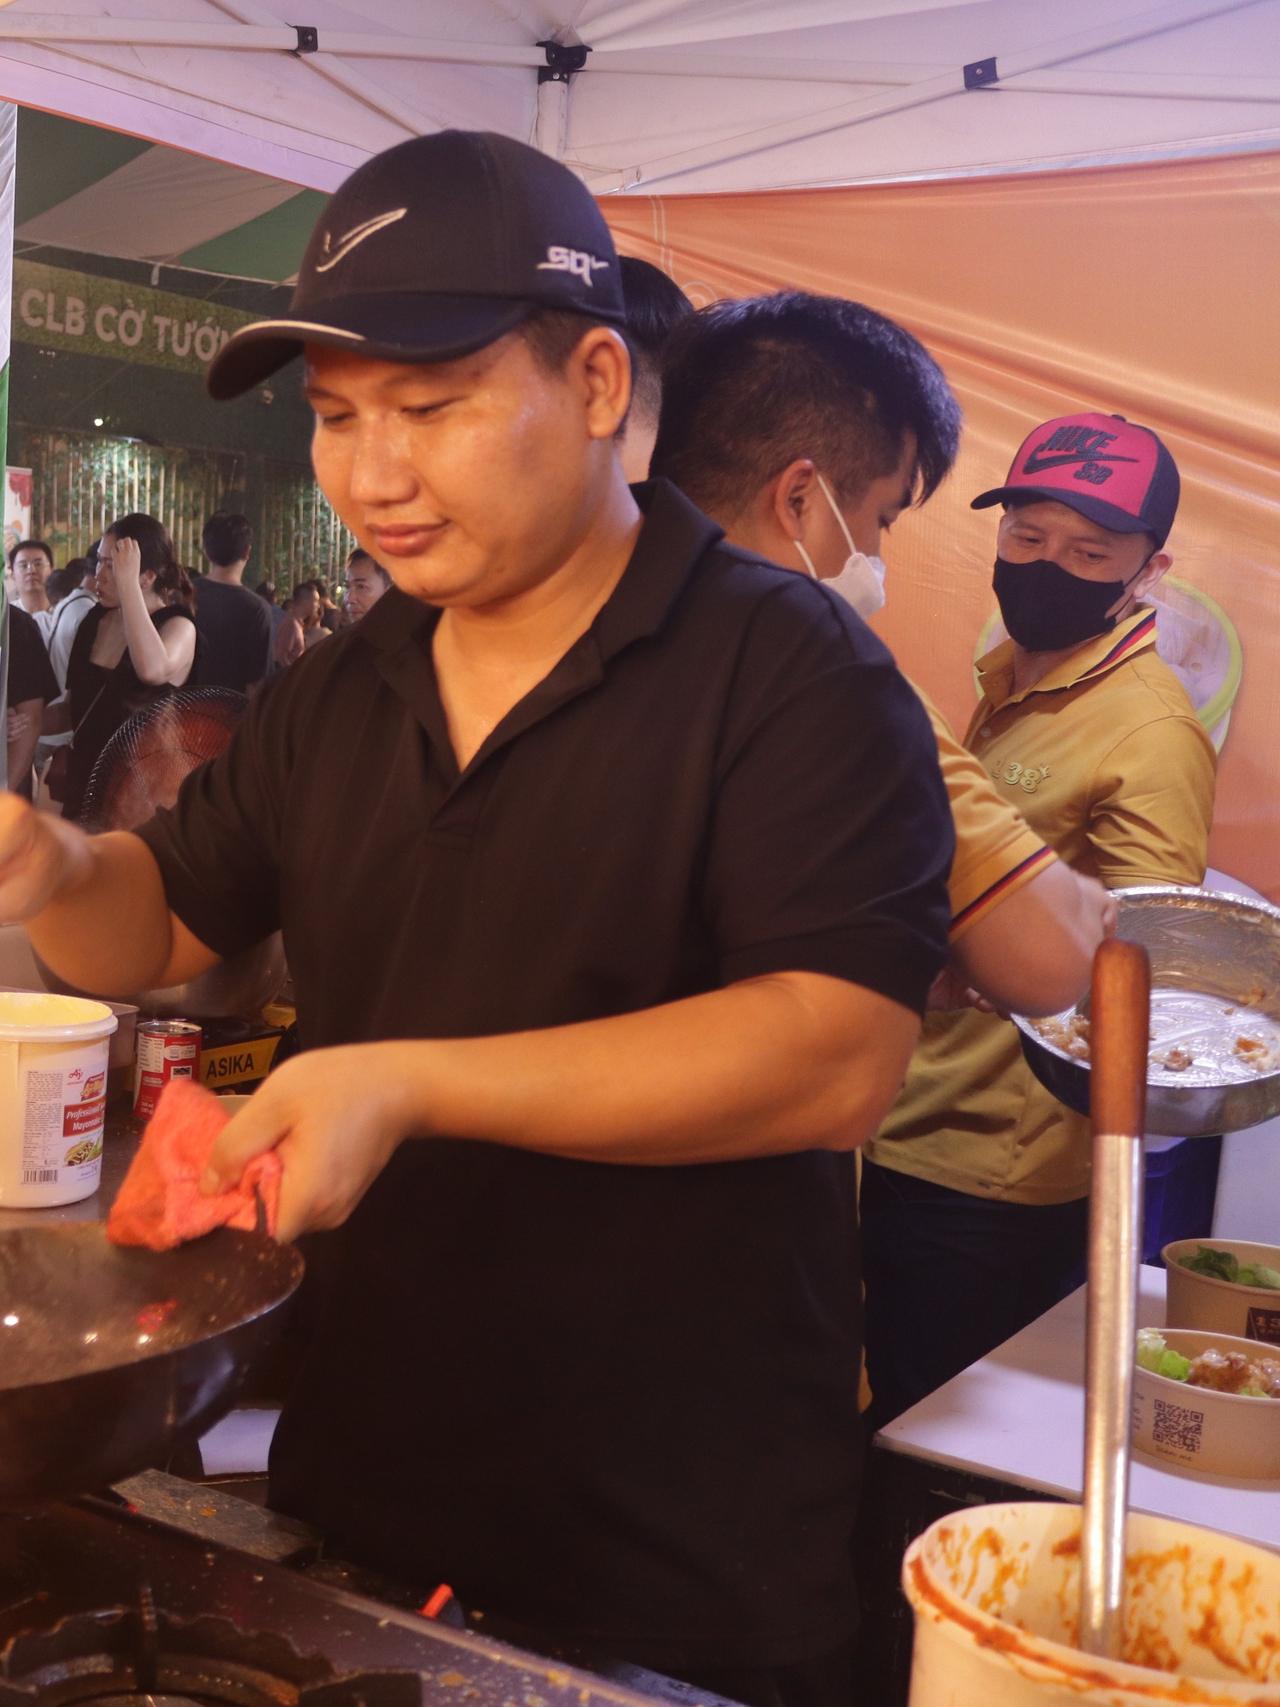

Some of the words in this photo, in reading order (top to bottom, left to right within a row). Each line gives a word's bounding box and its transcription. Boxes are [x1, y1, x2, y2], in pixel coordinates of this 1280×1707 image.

[21, 289, 86, 336] CLB
[95, 298, 147, 347] CỜ
[1037, 425, 1118, 455] NIKE
[1074, 462, 1113, 485] SB
[1004, 761, 1041, 794] 38
[206, 1053, 254, 1080] ASIKA
